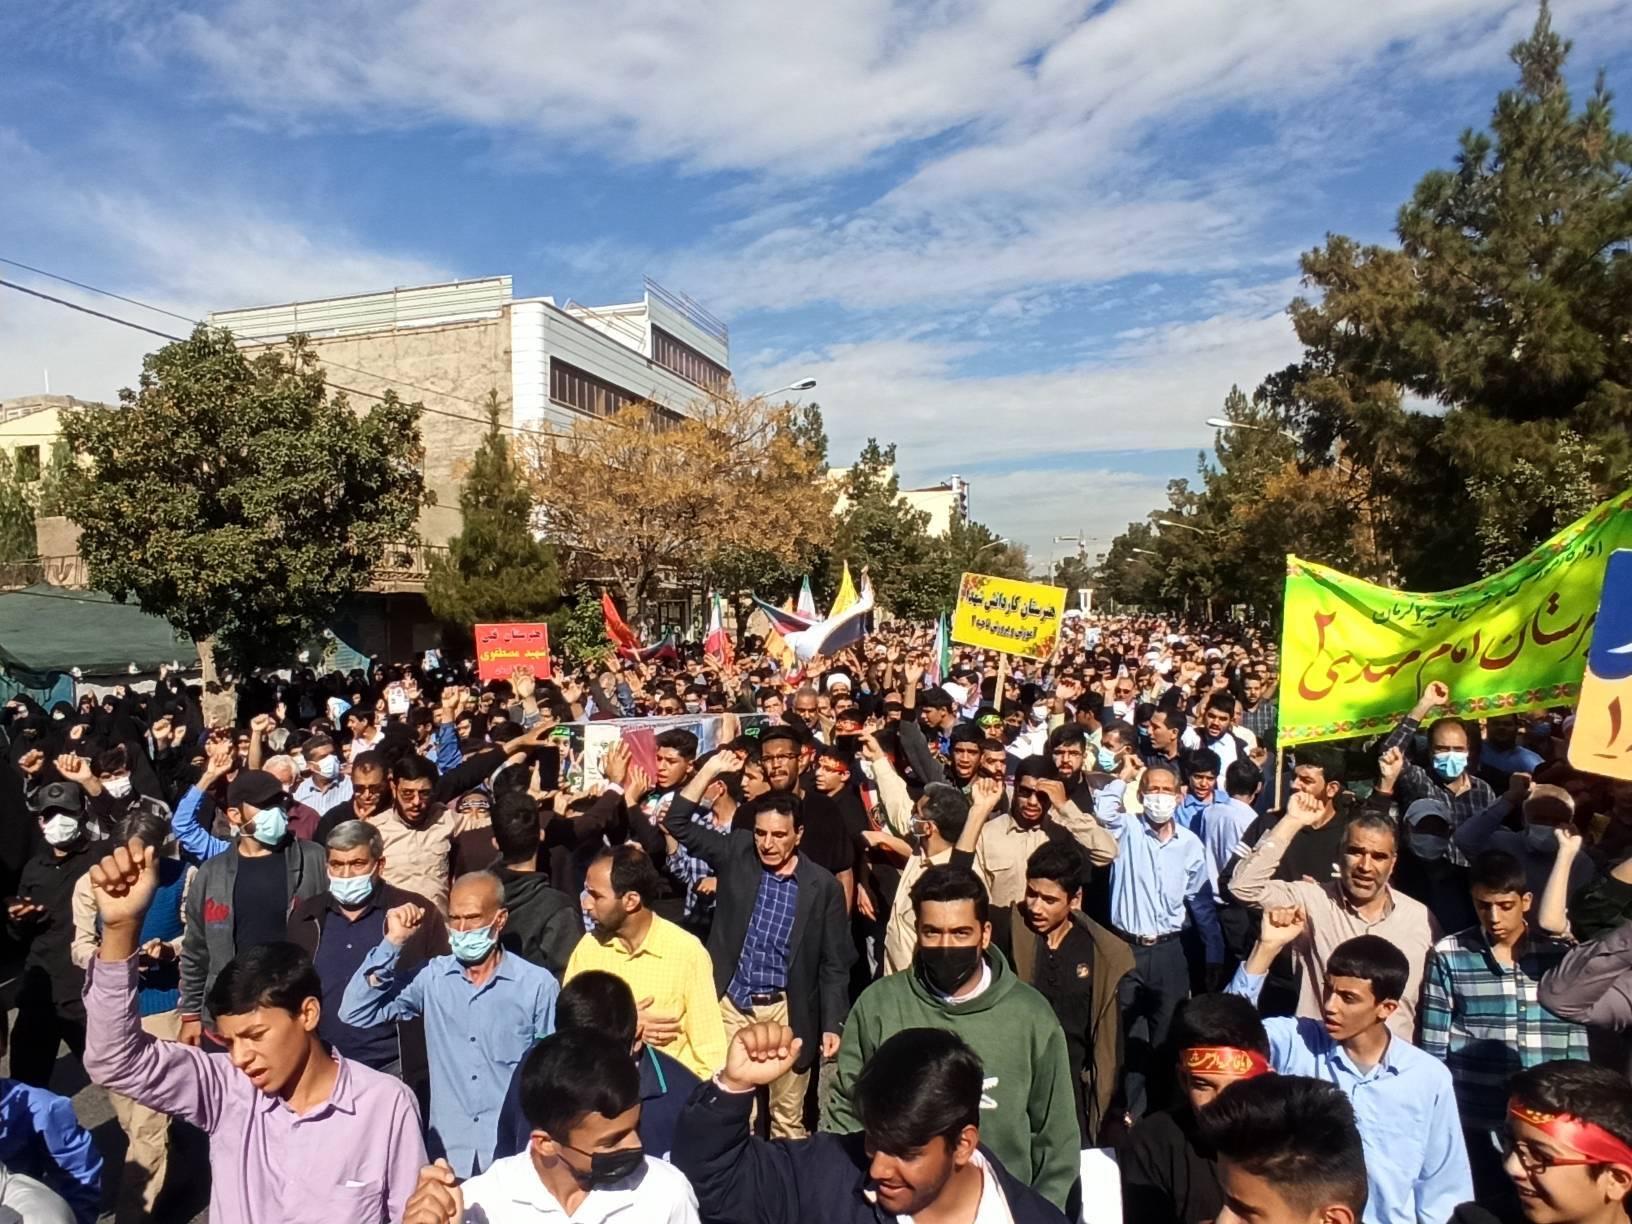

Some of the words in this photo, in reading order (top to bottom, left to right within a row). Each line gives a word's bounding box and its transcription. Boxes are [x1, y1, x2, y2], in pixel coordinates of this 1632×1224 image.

[984, 592, 1021, 614] کاردانش
[1020, 598, 1056, 623] هنرستان
[503, 629, 541, 643] هنرستان
[1016, 626, 1038, 641] آموزش
[1313, 610, 1337, 658] ۲
[480, 648, 520, 661] مصطفوی
[524, 649, 547, 660] شهید
[1416, 629, 1481, 700] امام
[1298, 650, 1421, 701] مهدی
